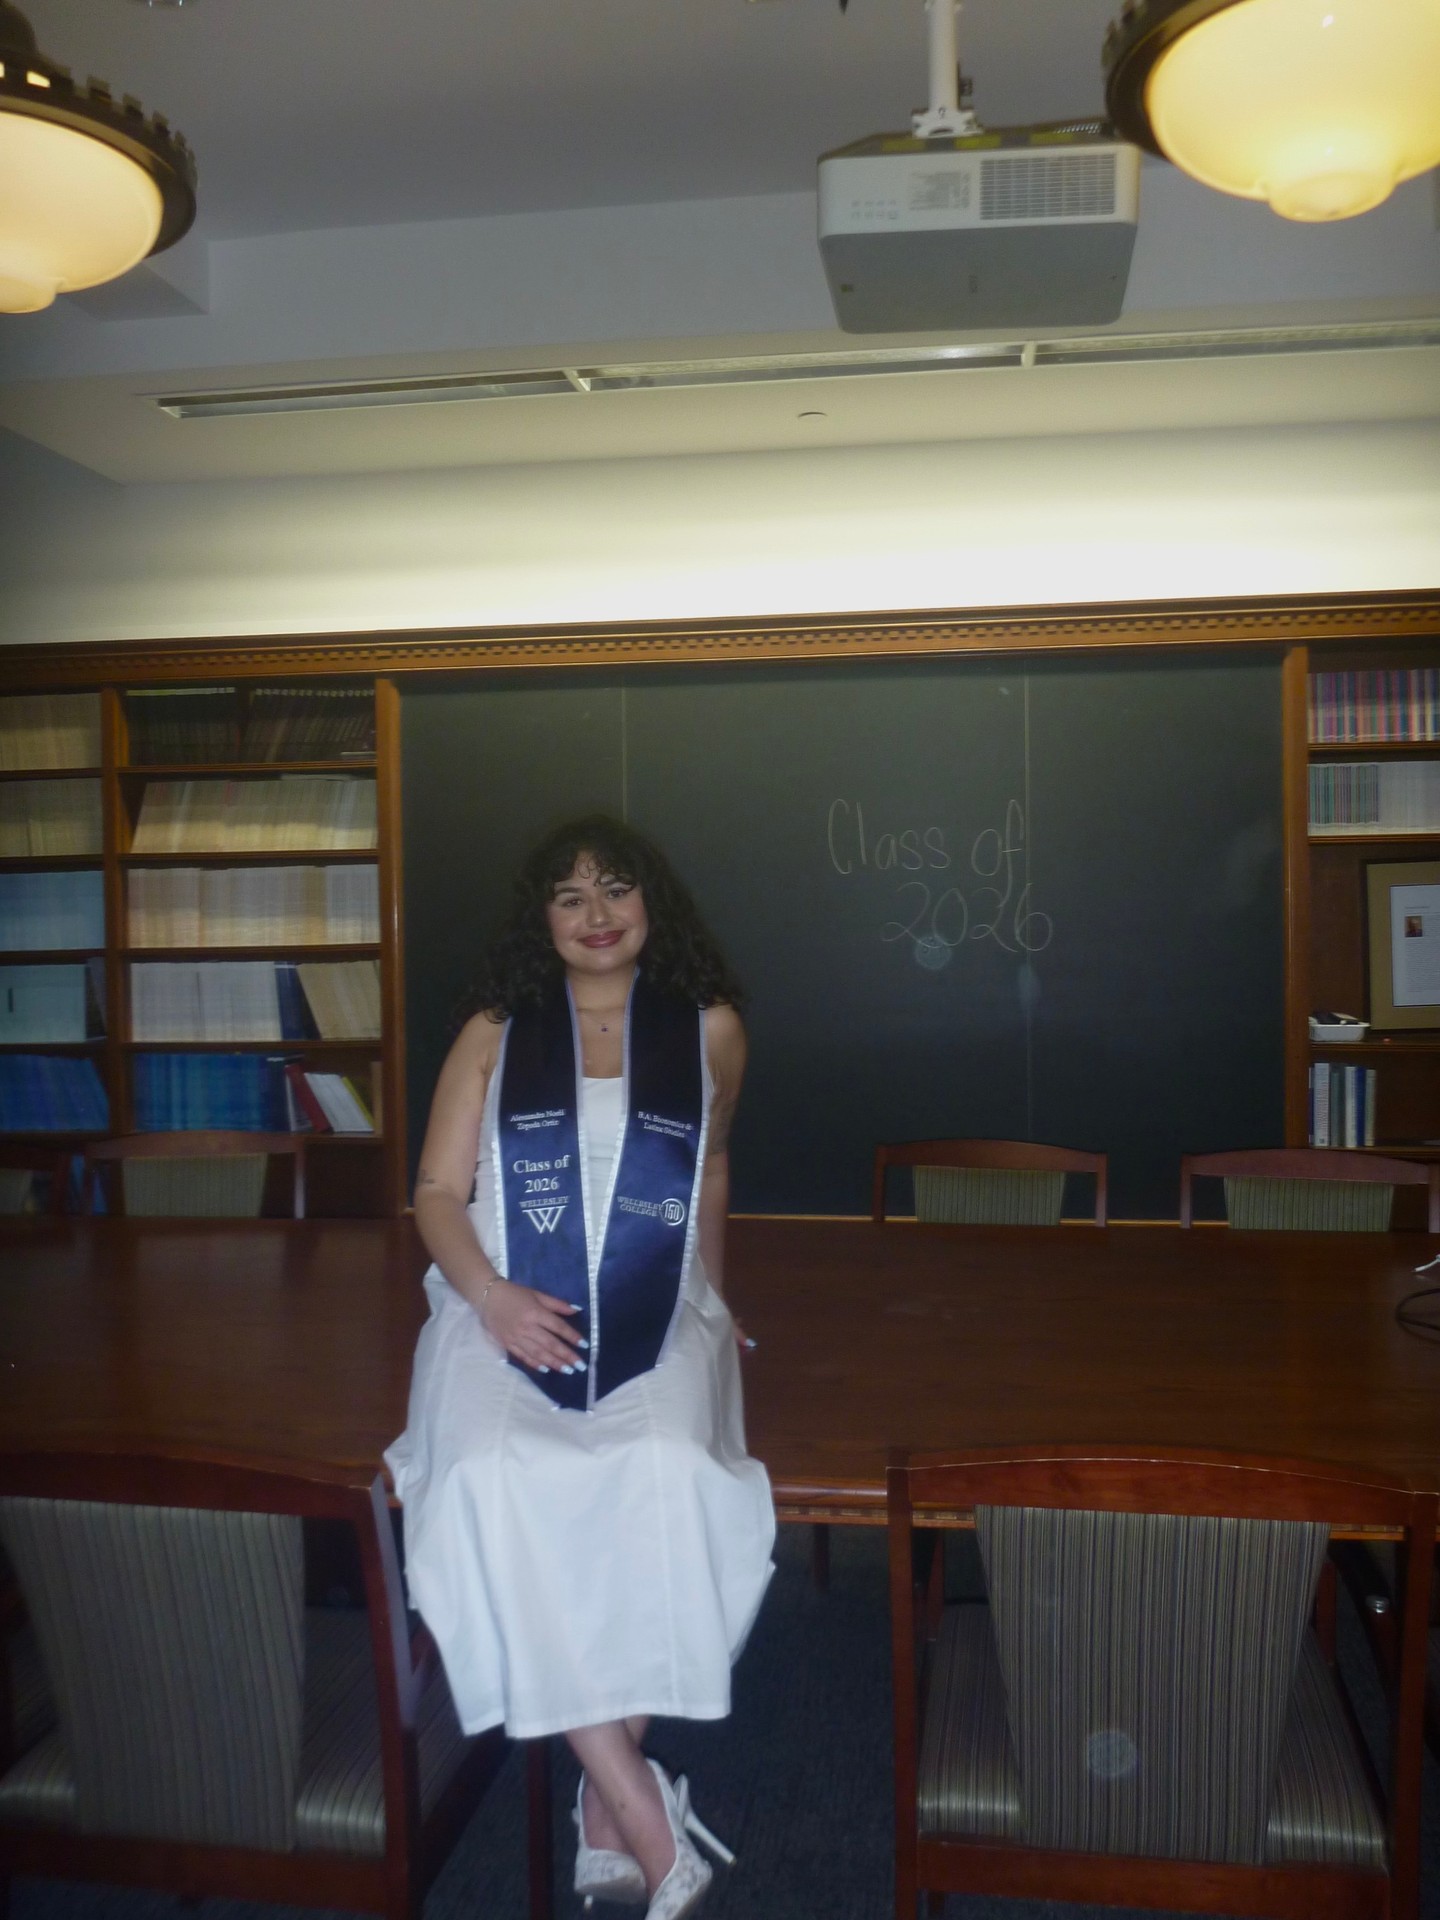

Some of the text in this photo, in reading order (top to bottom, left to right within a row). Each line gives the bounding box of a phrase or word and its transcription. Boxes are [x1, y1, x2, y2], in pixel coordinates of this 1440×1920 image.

[828, 799, 1025, 907] Class of
[882, 882, 1053, 952] 2026
[513, 1155, 570, 1173] Class of
[525, 1176, 559, 1193] 2026
[519, 1196, 569, 1208] WELLESLEY
[617, 1196, 663, 1210] WELLESLEY
[620, 1204, 658, 1216] COLLEGE
[522, 1205, 567, 1234] W
[664, 1203, 680, 1221] 150
